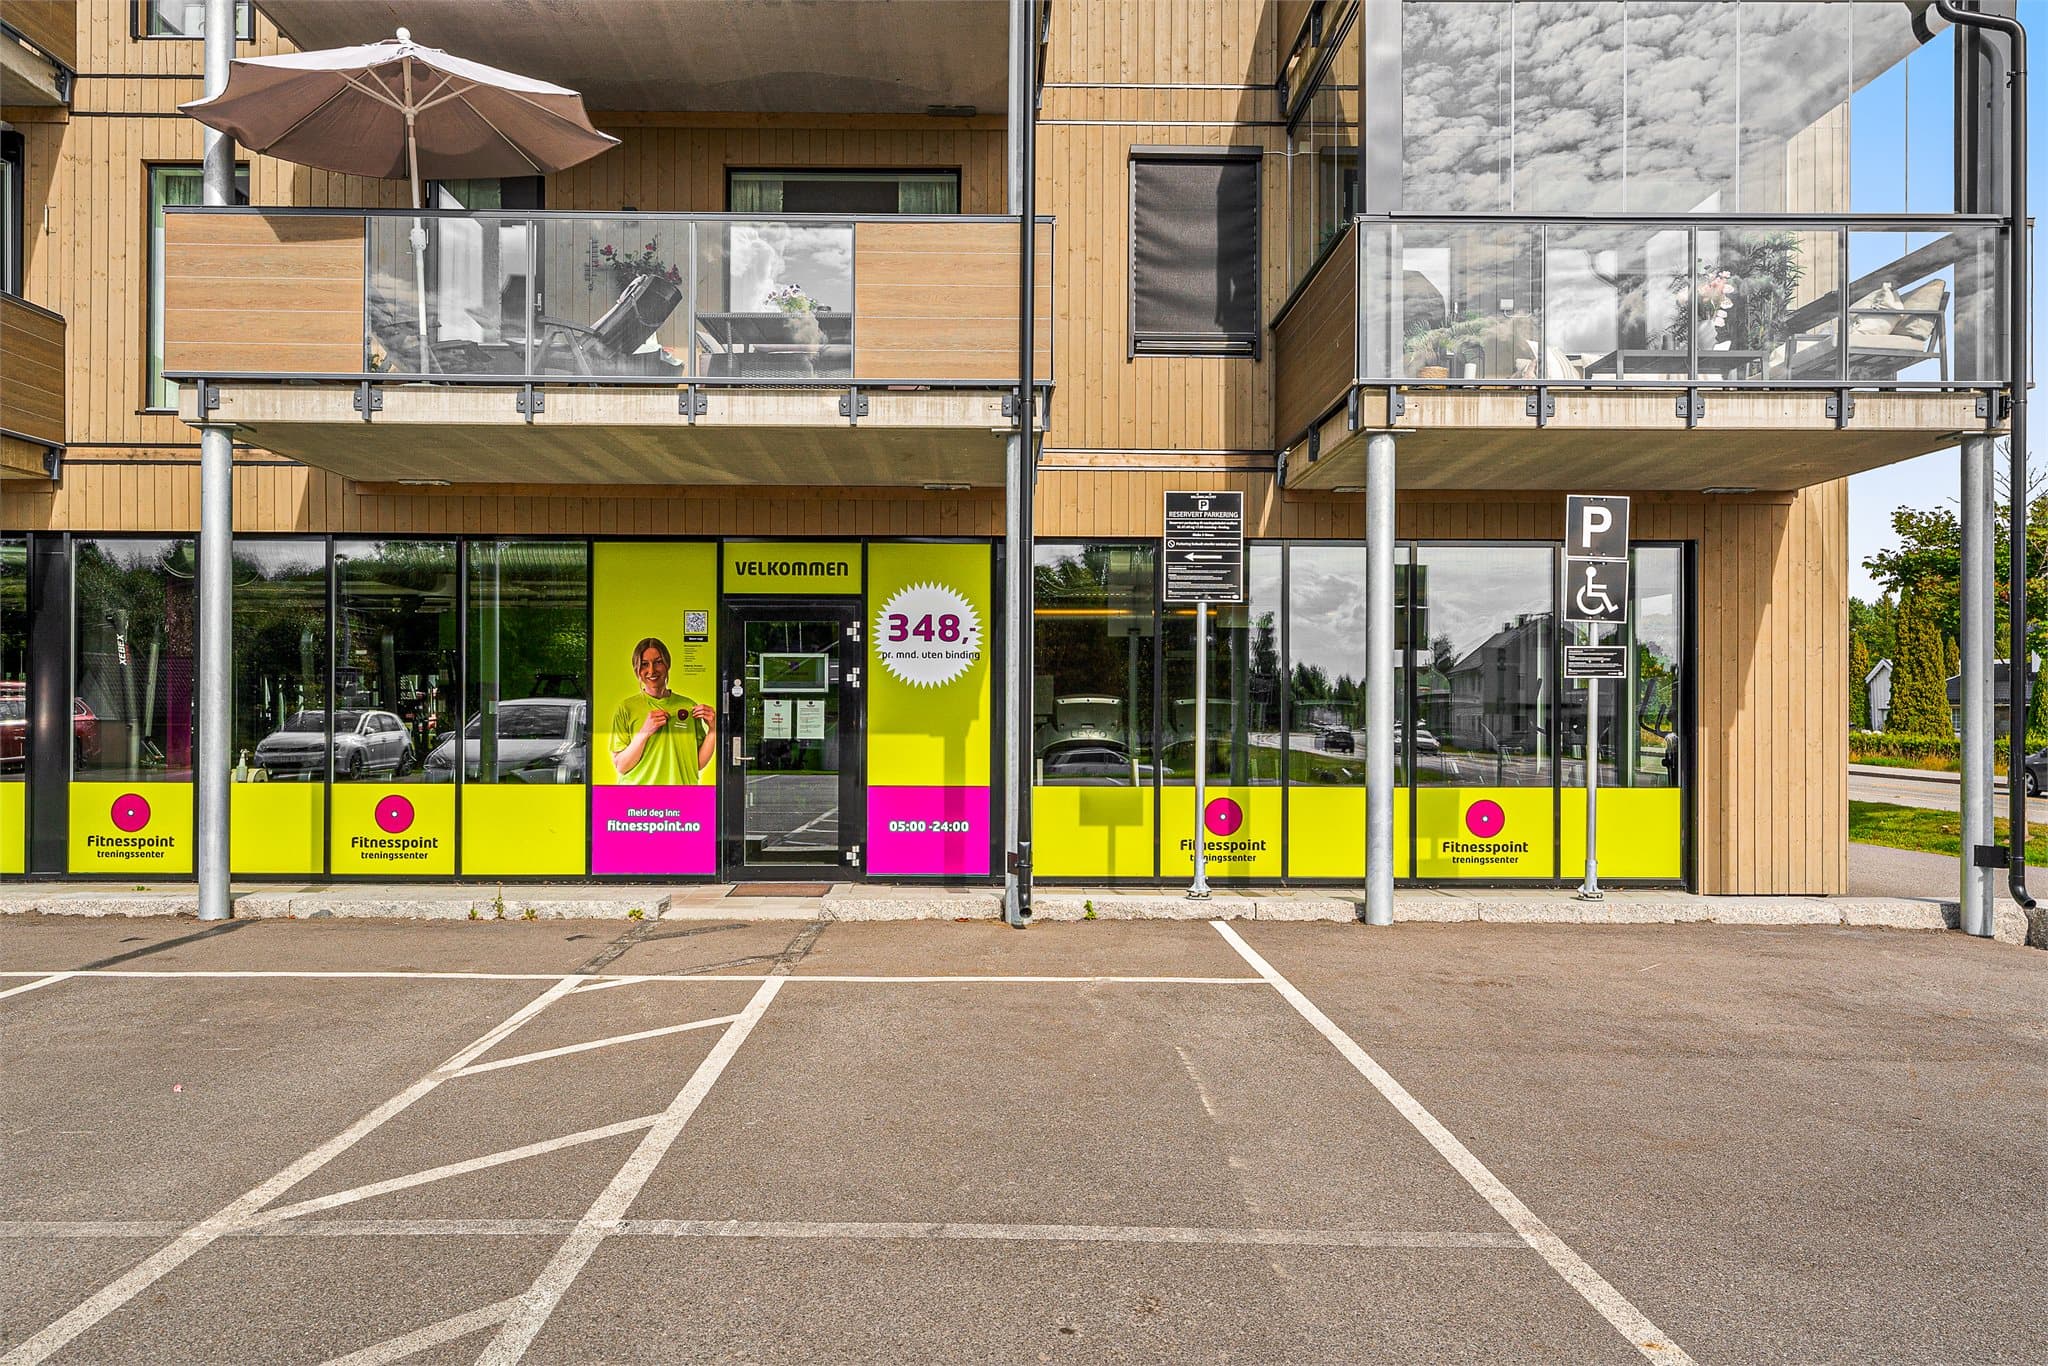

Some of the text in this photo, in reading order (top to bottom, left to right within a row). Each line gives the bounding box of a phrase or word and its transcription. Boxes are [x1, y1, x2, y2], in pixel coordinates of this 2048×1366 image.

[1582, 506, 1612, 548] P
[735, 561, 849, 576] VELKOMMEN
[116, 633, 128, 666] XEBEX
[882, 650, 980, 661] pr. mnd. uten binding
[627, 808, 648, 817] Meld
[649, 808, 664, 818] deg
[607, 820, 700, 834] fitnesspoint.no
[889, 820, 926, 832] 05:00
[87, 835, 175, 849] Fitnesspoint
[351, 836, 439, 851] Fitnesspoint
[1442, 841, 1529, 855] Fitnesspoint
[97, 850, 165, 860] treningssenter
[361, 851, 428, 861] treningssenter
[1190, 854, 1257, 863] tningssenter
[1452, 856, 1519, 865] treningssenter
